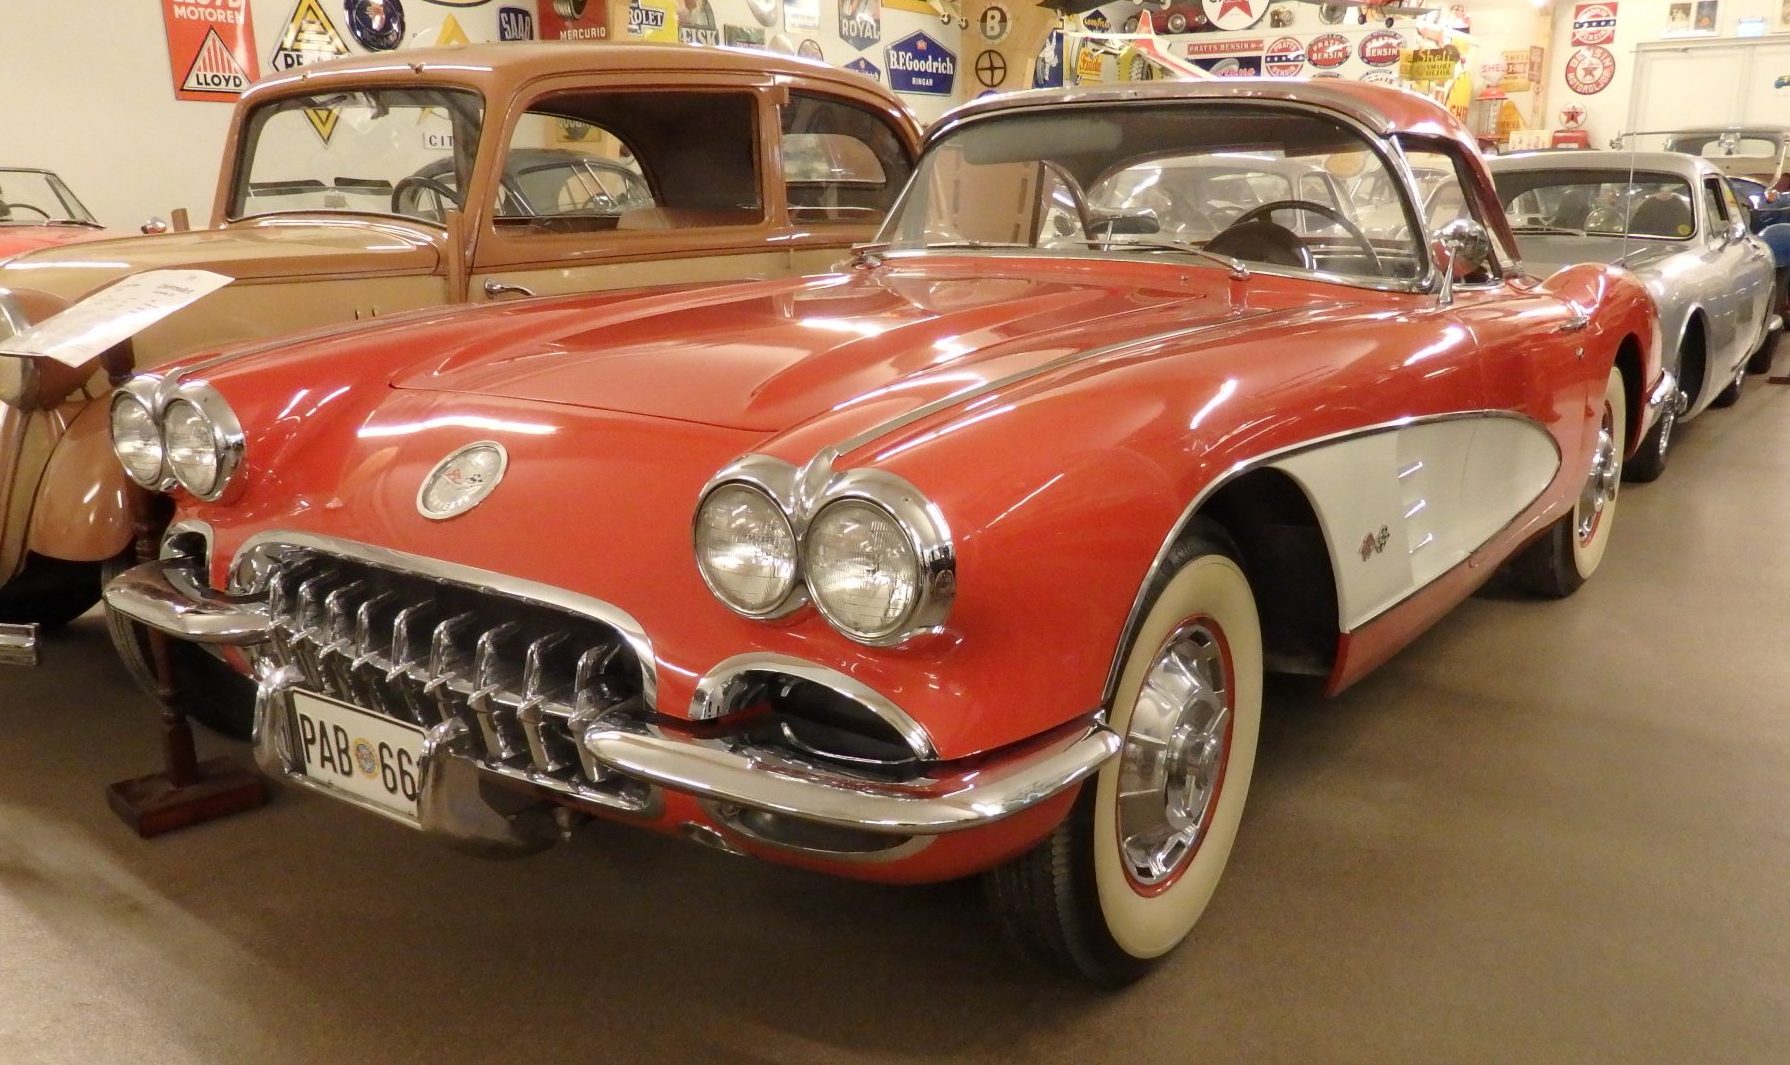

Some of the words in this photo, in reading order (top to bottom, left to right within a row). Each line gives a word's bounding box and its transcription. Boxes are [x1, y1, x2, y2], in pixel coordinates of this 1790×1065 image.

[174, 5, 244, 24] MOTOREN
[501, 13, 530, 40] SAAB
[560, 27, 606, 40] MERCURIO
[841, 18, 880, 40] ROYAL
[1189, 44, 1218, 53] PRATTS
[1220, 42, 1249, 52] BENSIN
[1366, 47, 1398, 57] BENSIN
[1312, 51, 1343, 60] BENSIN
[196, 73, 242, 88] LLOYD
[912, 76, 934, 87] RINGAR
[300, 713, 353, 776] PAB
[379, 741, 420, 802] 66
